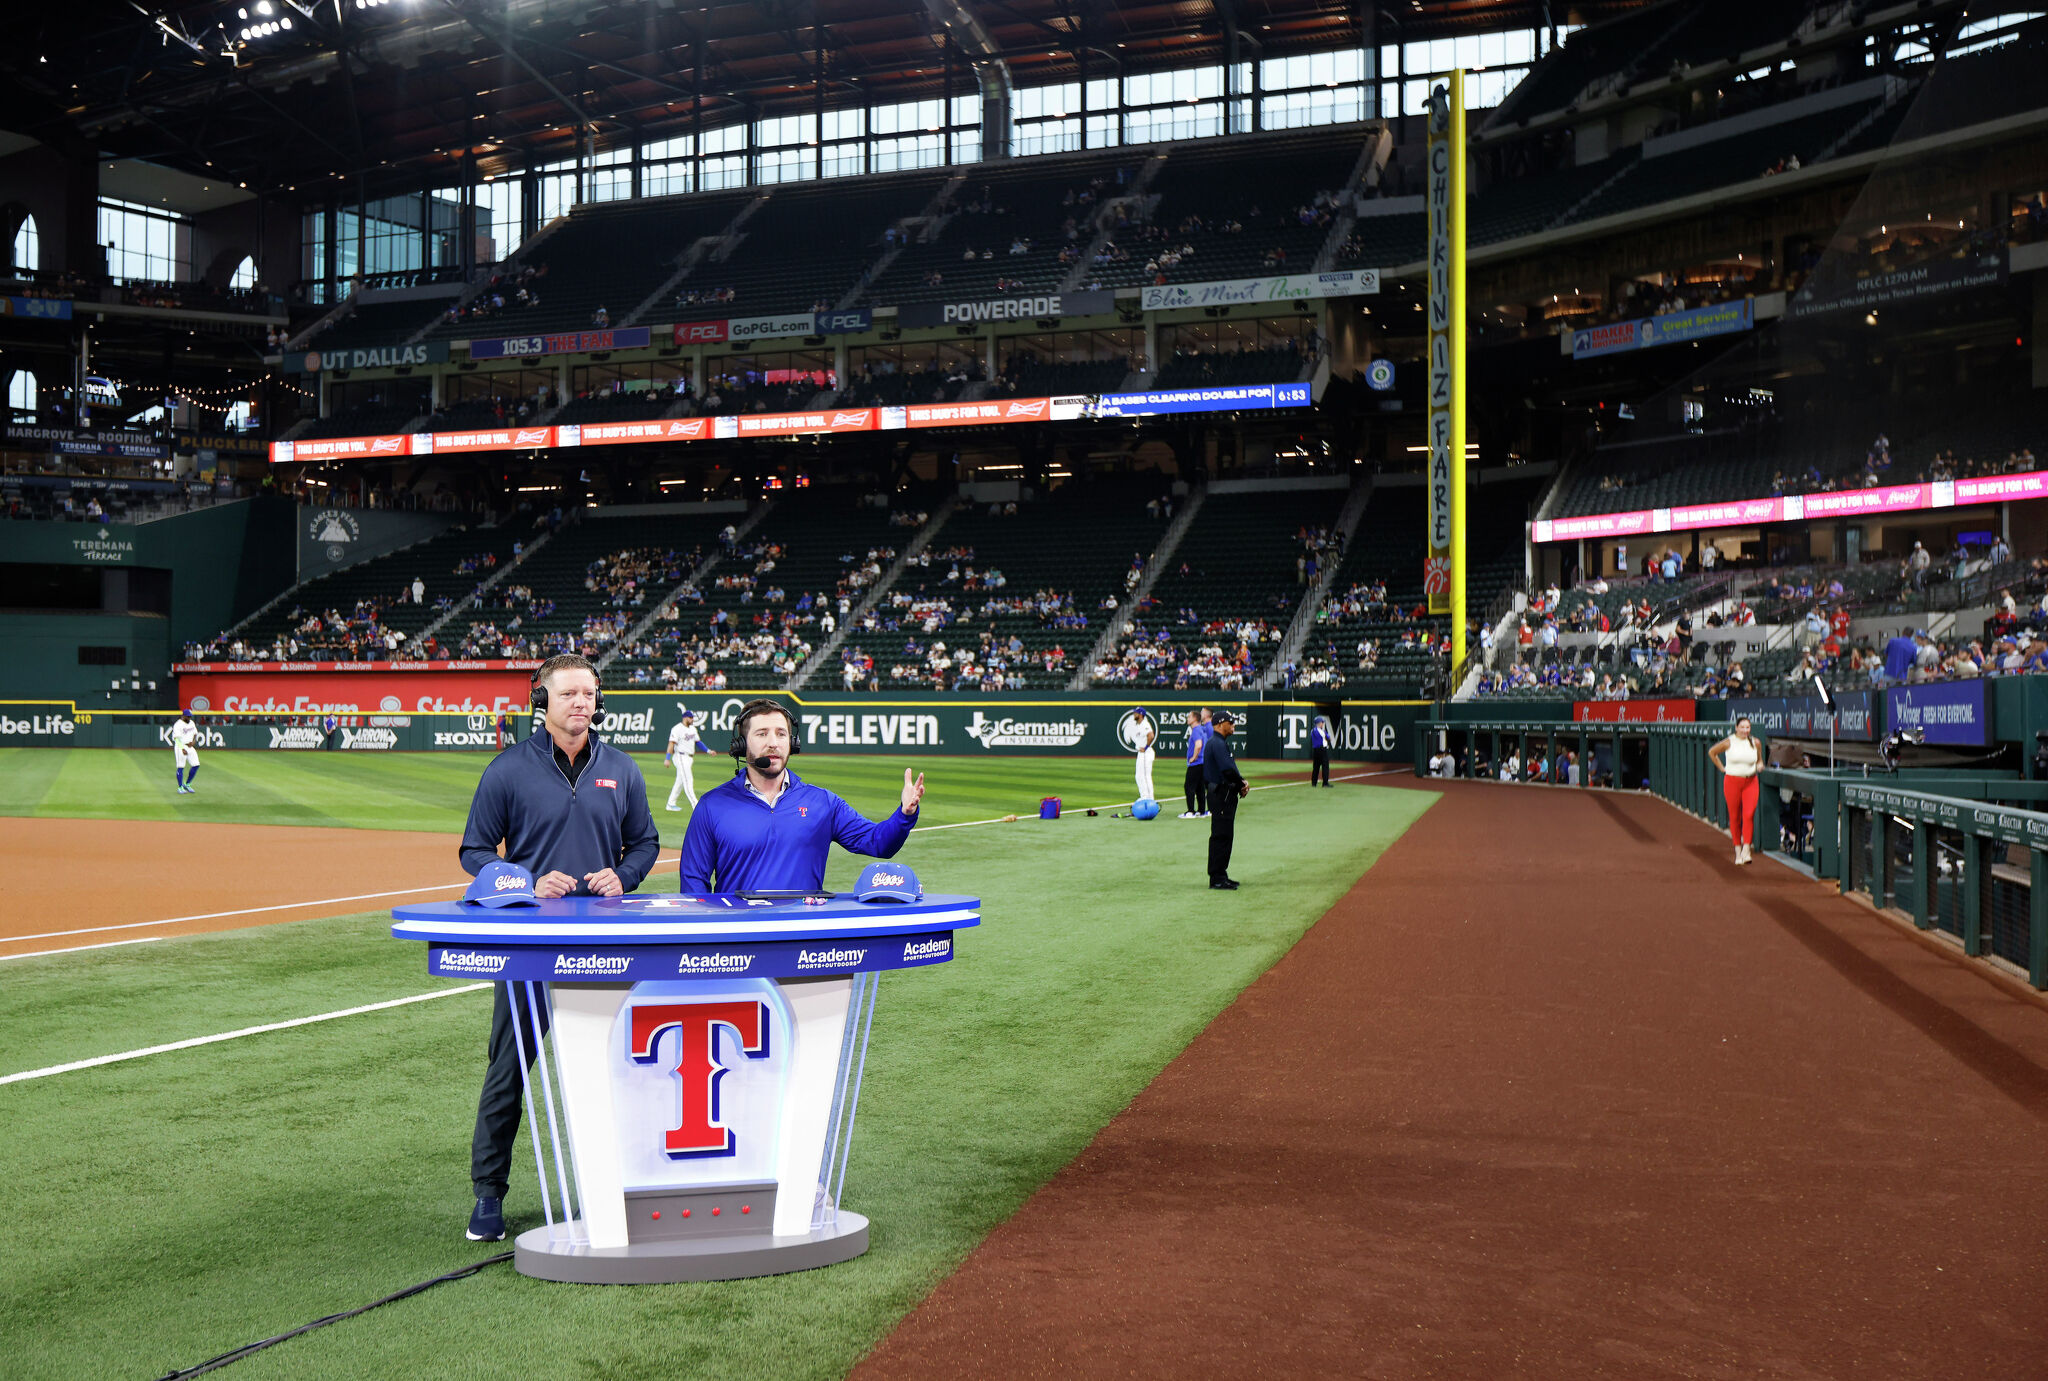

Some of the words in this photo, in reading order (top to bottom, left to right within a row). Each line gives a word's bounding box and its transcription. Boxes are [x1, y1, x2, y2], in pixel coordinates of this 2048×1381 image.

[1431, 147, 1447, 323] CHIKIN
[1857, 279, 1882, 291] KFLC
[1885, 273, 1908, 285] 1270
[1910, 268, 1928, 281] AM
[1892, 288, 1914, 300] Texas
[1916, 282, 1949, 297] Rangers
[1951, 280, 1962, 289] en
[1963, 272, 1998, 288] Español
[1146, 289, 1194, 308] Blue
[1198, 282, 1261, 302] Mint
[1267, 278, 1312, 299] Thai
[944, 297, 1062, 322] POWERADE
[732, 320, 810, 336] GoPGL.com
[831, 314, 868, 329] PGL
[1662, 318, 1693, 332] Great
[1695, 311, 1738, 326] Service
[689, 325, 724, 340] PGL
[1592, 322, 1634, 341] BAKER
[502, 338, 542, 356] 105.3
[545, 336, 576, 352] THE
[580, 332, 614, 350] FAN
[322, 352, 348, 371] UT
[353, 345, 427, 368] DALLAS
[1433, 342, 1449, 399] IZ
[1112, 394, 1147, 405] BASES
[1148, 391, 1200, 404] CLEARING
[1201, 389, 1247, 401] DOUBLE
[1248, 388, 1271, 399] FOR
[910, 409, 930, 421] THIS
[932, 408, 959, 419] BUD'S
[960, 407, 979, 418] FOR
[980, 405, 1000, 417] YOU.
[583, 427, 602, 439] THIS
[603, 426, 626, 438] BUD'S
[628, 425, 645, 437] FOR
[646, 424, 663, 436] YOU.
[741, 418, 761, 431] THIS
[762, 417, 787, 430] BUD'S
[788, 416, 806, 428] FOR
[807, 415, 826, 427] YOU.
[7, 426, 75, 441] HARGROVE
[97, 431, 152, 445] ROOFING
[180, 436, 269, 451] PLUCKERS
[436, 436, 453, 446] THIS
[454, 434, 475, 446] BUD'S
[476, 433, 492, 445] FOR
[493, 432, 510, 444] YOU.
[59, 442, 102, 452] TEREMANA
[119, 444, 161, 454] TEREMANA
[296, 444, 313, 455] THIS
[335, 441, 350, 453] FOR
[1434, 419, 1448, 542] FARE
[1958, 484, 1977, 497] THIS
[2006, 480, 2022, 493] FOR
[73, 540, 133, 551] TEREMANA
[74, 715, 92, 725] 410
[1791, 708, 1807, 730] American
[1841, 705, 1864, 731] American
[1923, 705, 1937, 724] FRESH
[1937, 704, 1947, 724] FOR
[1947, 703, 1976, 724] EVERYONE.
[0, 715, 31, 734] be
[33, 714, 75, 734] Life
[1000, 718, 1084, 735] Germania
[159, 725, 224, 747] Kota
[282, 727, 318, 743] ARROW
[354, 727, 390, 743] ARROW
[613, 733, 650, 745] Rental
[798, 806, 808, 817] T
[904, 938, 951, 956] Academy
[440, 949, 507, 971] Academy
[554, 954, 631, 973] Academy
[678, 953, 752, 972] Academy
[798, 949, 864, 968] Academy
[903, 950, 948, 962] SPORTS+OUTDOORS
[440, 964, 499, 973] SPORTS+OUTDOORS
[798, 961, 858, 970] SPORTS+OUTDOORS
[630, 1000, 770, 1160] T
